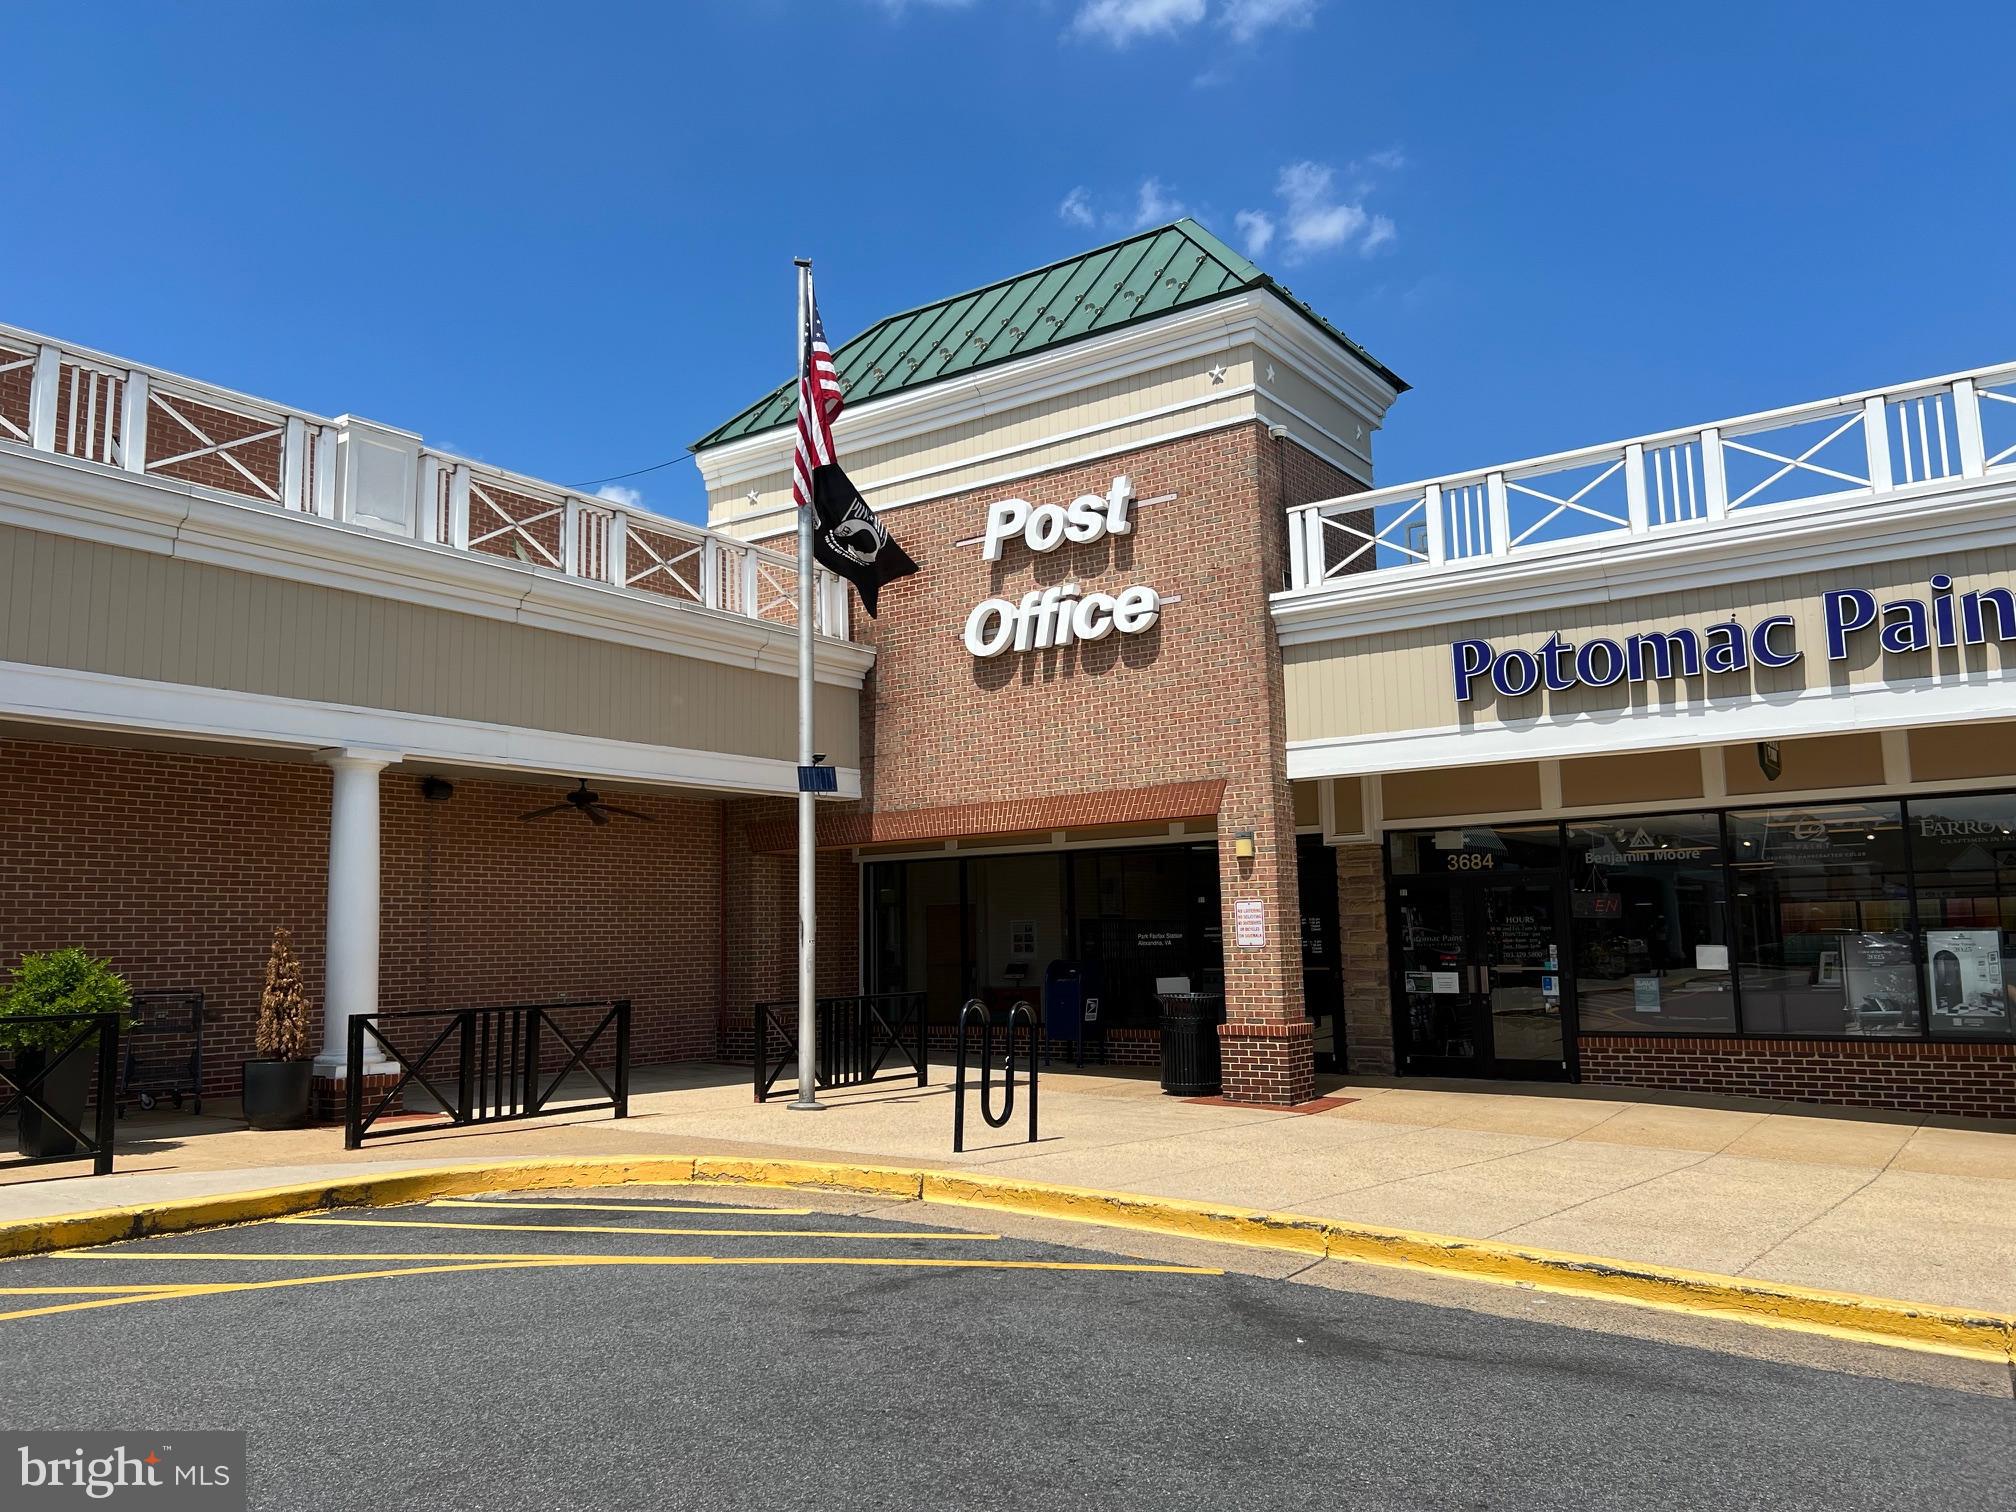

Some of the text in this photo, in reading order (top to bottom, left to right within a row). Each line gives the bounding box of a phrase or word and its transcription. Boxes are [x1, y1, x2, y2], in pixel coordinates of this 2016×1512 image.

[982, 475, 1137, 562] Post
[964, 583, 1160, 658] Office
[1451, 573, 2016, 702] Potomac Pain
[1447, 853, 1495, 871] 3684
[1585, 849, 1701, 866] Benjamin Moore
[1575, 897, 1620, 913] OEN
[1505, 915, 1535, 924] HOURS
[1442, 934, 1463, 942] Paint
